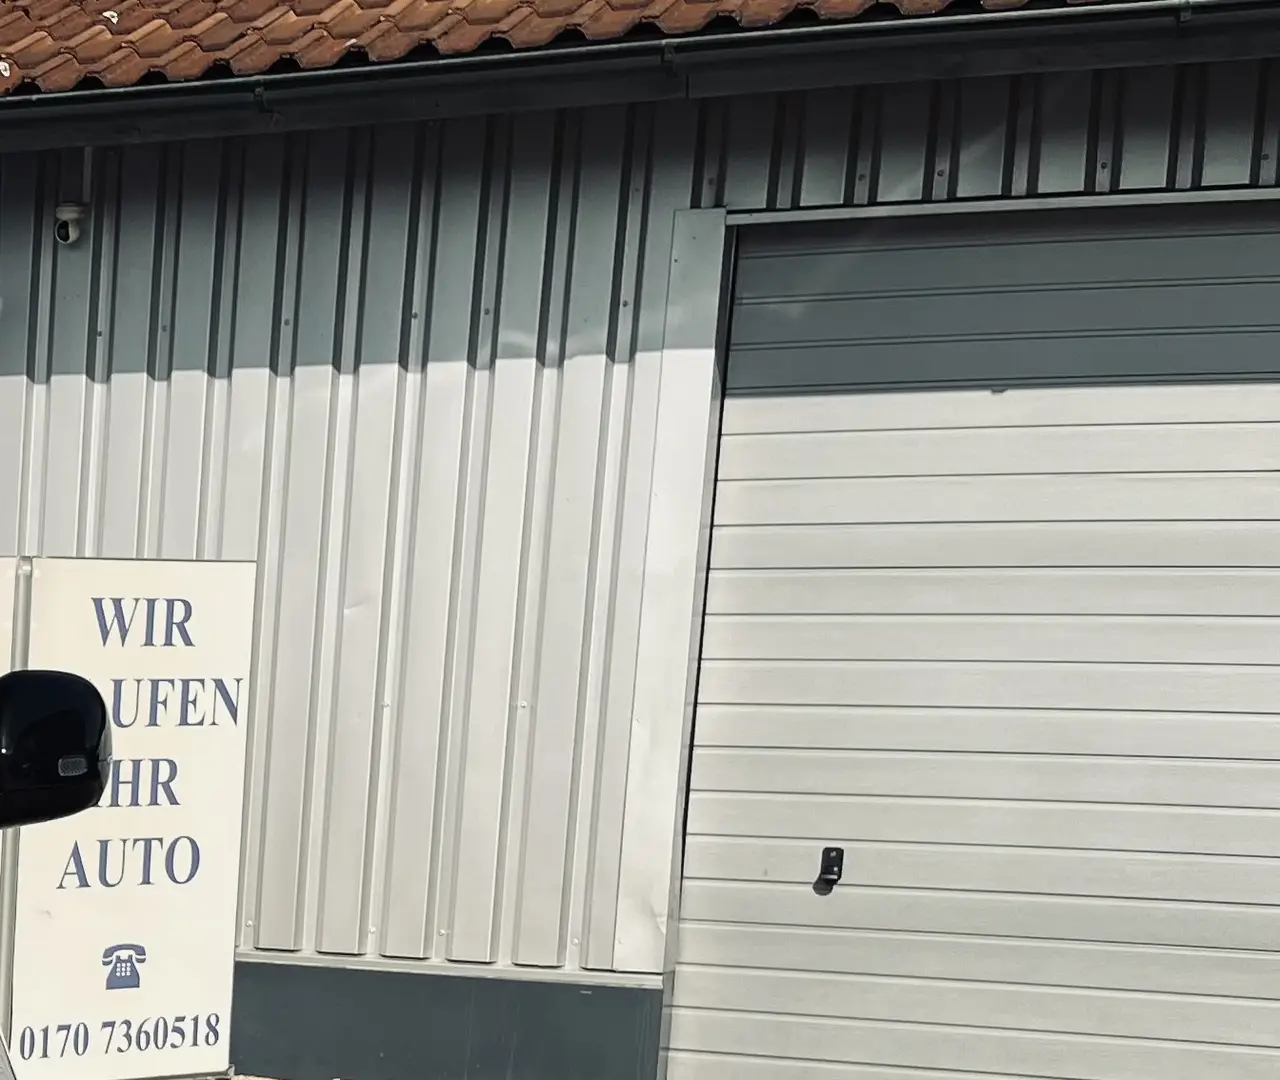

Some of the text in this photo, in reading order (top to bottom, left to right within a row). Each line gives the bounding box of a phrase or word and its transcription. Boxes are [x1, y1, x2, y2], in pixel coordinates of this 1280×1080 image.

[90, 597, 196, 648] WIR
[110, 677, 244, 729] UFEN
[95, 757, 181, 808] HR
[56, 835, 201, 889] AUTO
[19, 1012, 220, 1061] 0170 7360518
